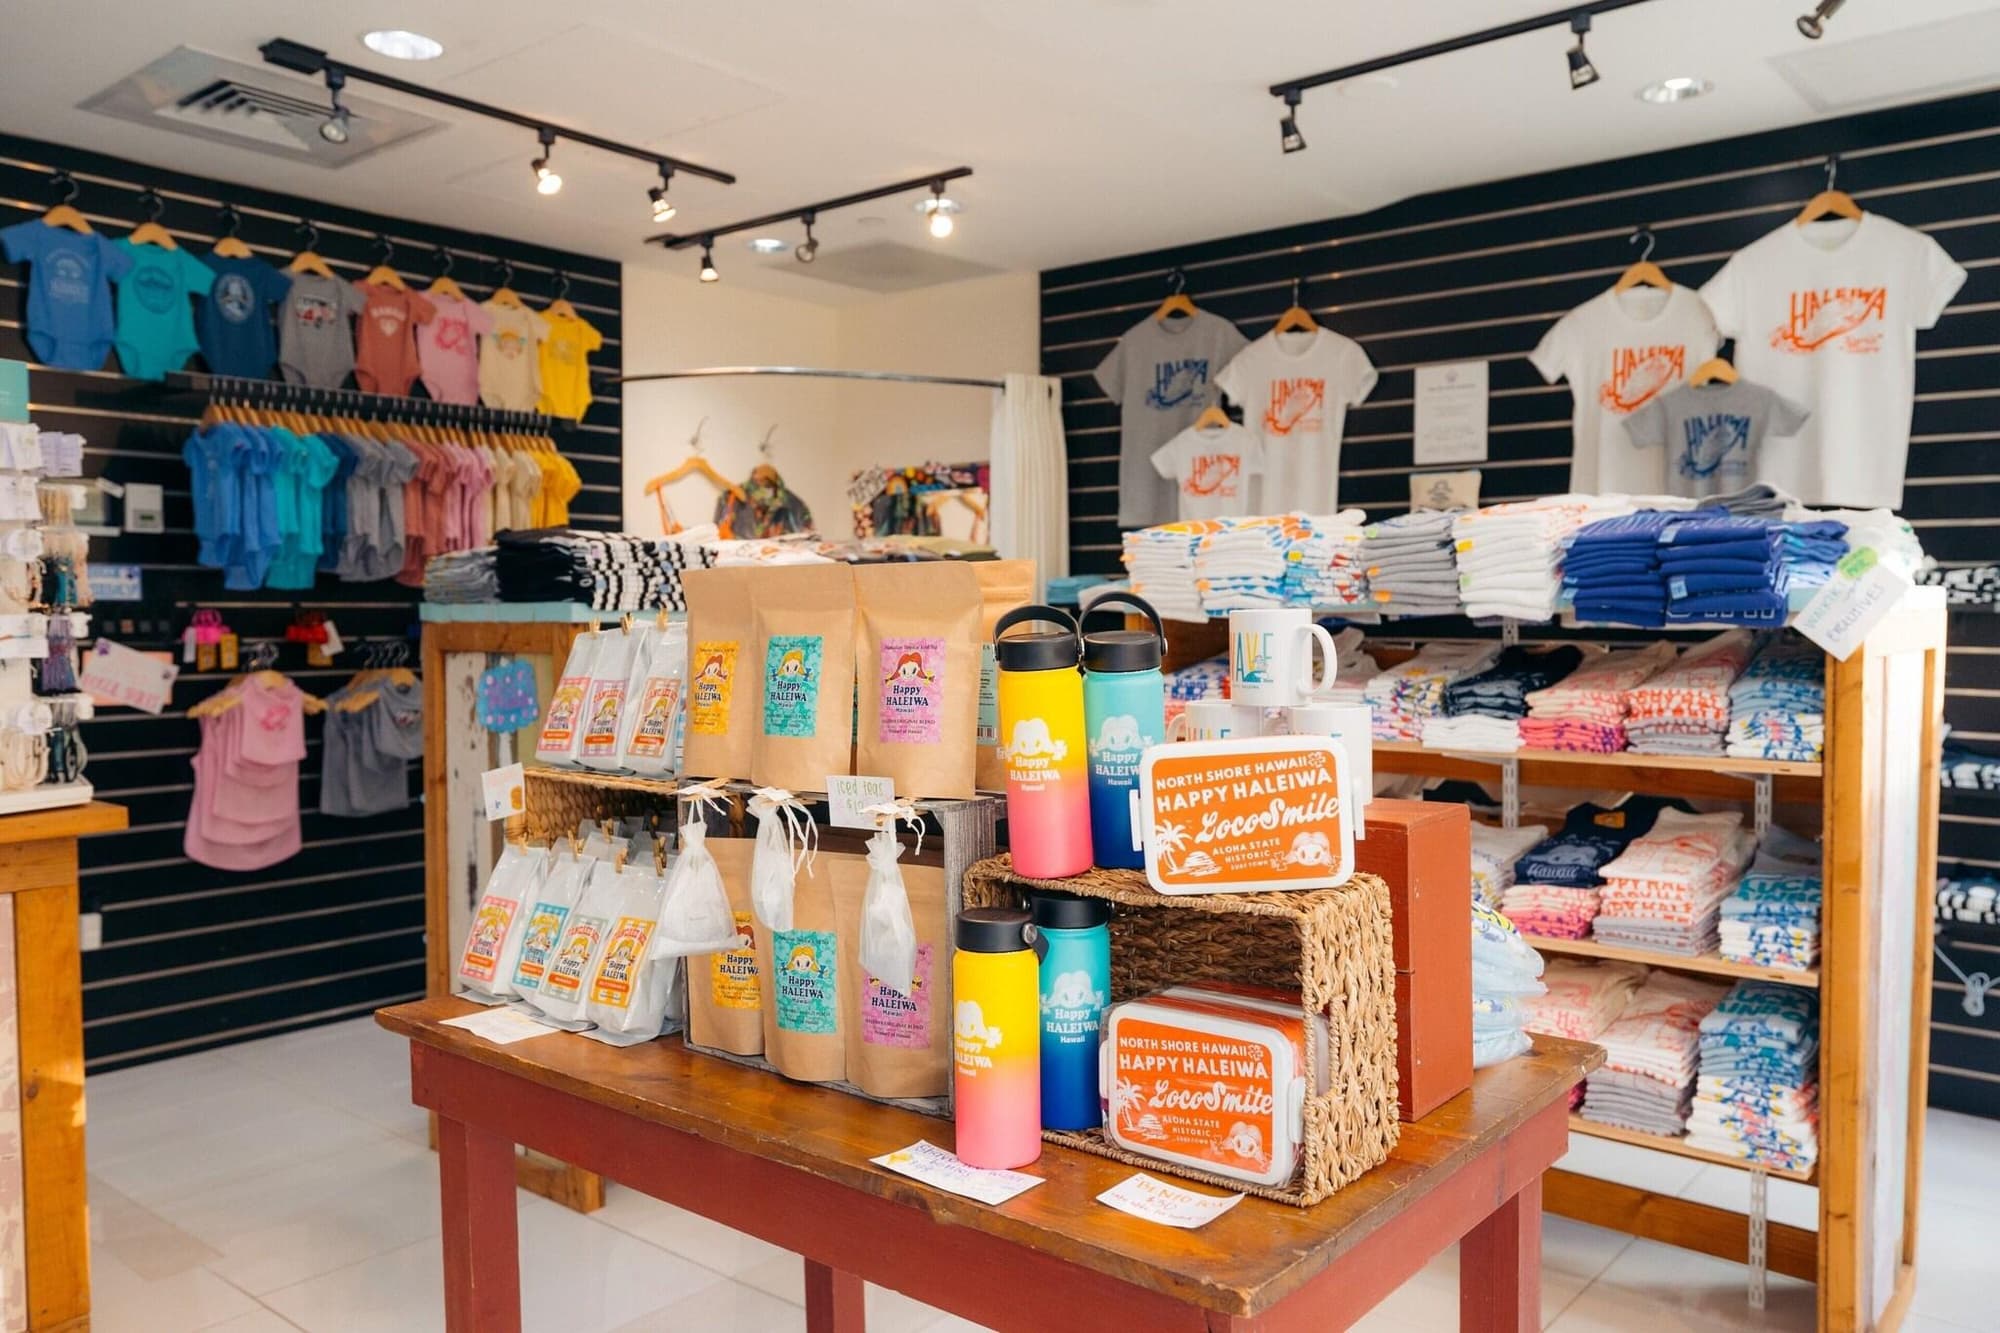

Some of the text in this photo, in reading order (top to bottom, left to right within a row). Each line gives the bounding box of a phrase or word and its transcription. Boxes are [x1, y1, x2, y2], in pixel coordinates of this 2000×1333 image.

[778, 681, 802, 691] Happy
[893, 685, 921, 696] Happy
[770, 692, 806, 702] HALEIWA
[886, 697, 929, 707] HALEIWA
[1015, 756, 1049, 770] Happy
[1102, 751, 1137, 765] Happy
[1010, 769, 1061, 782] HALEIWA
[1095, 764, 1140, 777] HALEIW
[1156, 756, 1307, 790] NORTH SHORE HAWAII
[1156, 768, 1333, 813] HAPPY HALEIWA
[1194, 792, 1340, 844] LocoSmile
[1212, 837, 1281, 856] ALOHA STATE
[1225, 850, 1270, 864] HISTORIC
[727, 954, 754, 965] Happy
[789, 976, 815, 987] Happy
[782, 986, 824, 999] HALEIWA
[872, 997, 917, 1012] HALEIWA
[1054, 1008, 1091, 1021] Happy
[1046, 1020, 1098, 1034] HALEIWA
[1060, 1035, 1086, 1043] Hawaii
[1120, 1037, 1246, 1057] NORTH SHORE HAWAII
[1119, 1054, 1269, 1079] HAPPY HALEIWA
[1163, 1115, 1220, 1129] ALOHA STATE
[1172, 1127, 1211, 1138] HISTORIC
